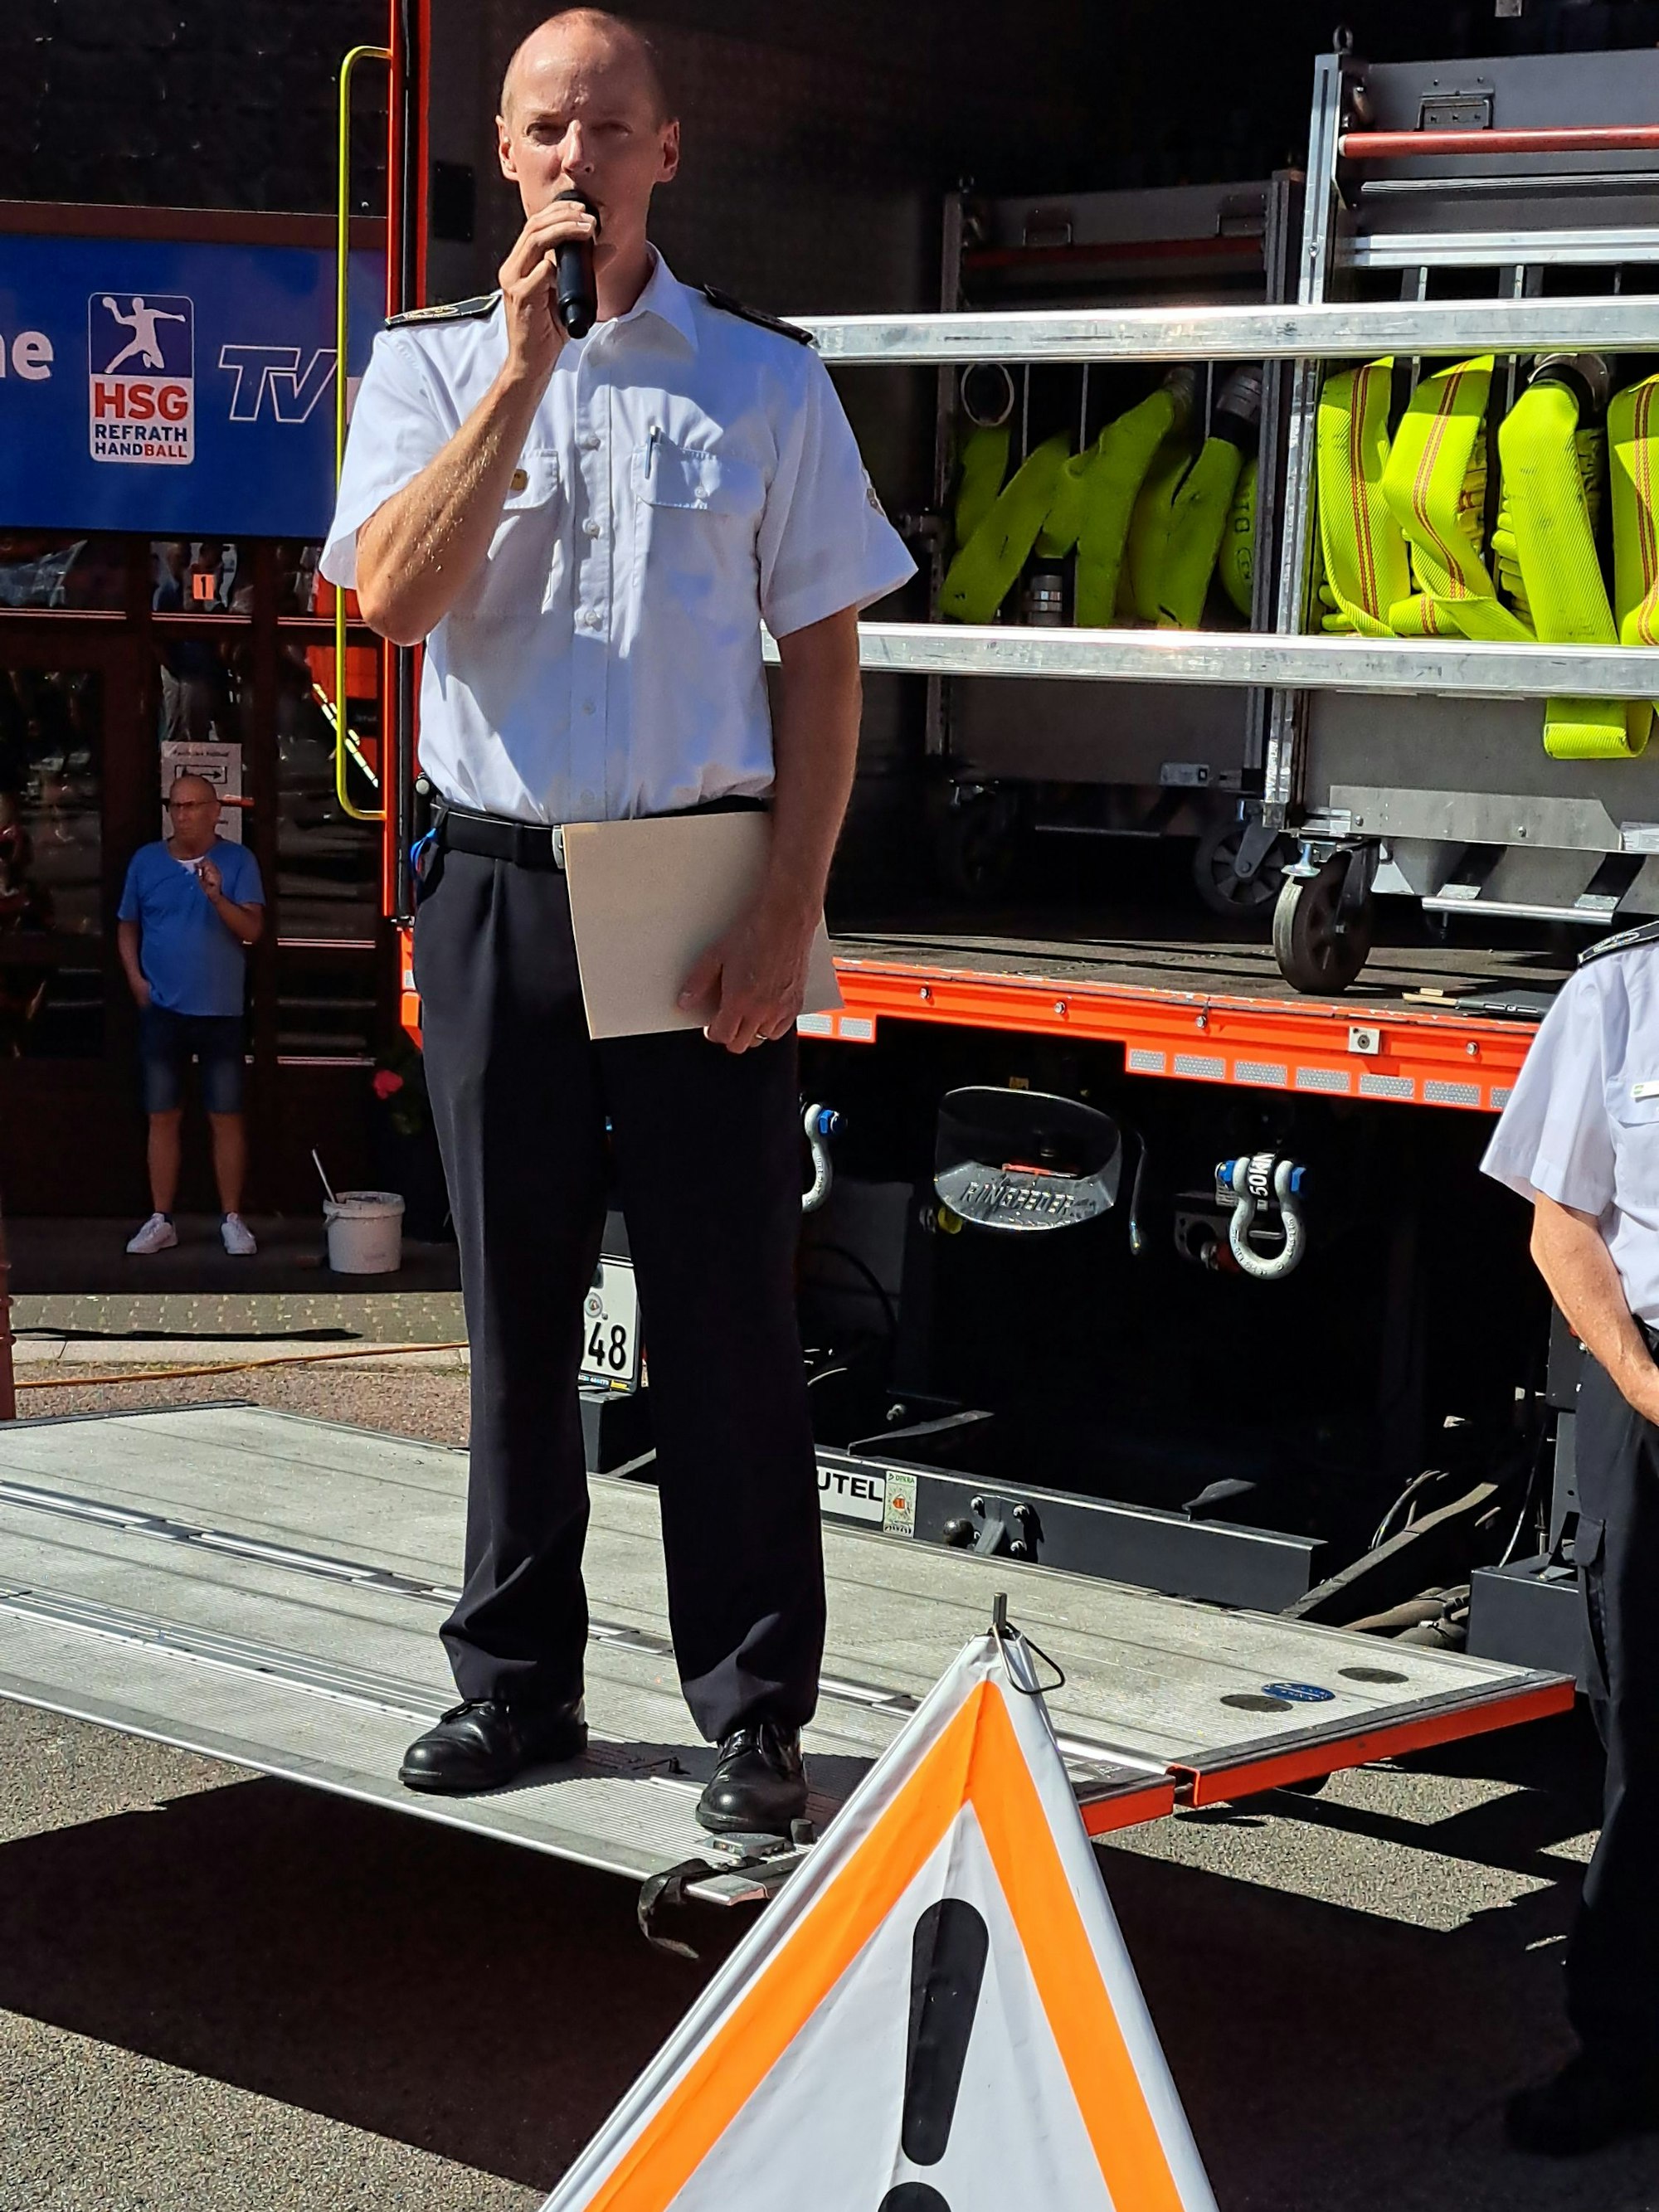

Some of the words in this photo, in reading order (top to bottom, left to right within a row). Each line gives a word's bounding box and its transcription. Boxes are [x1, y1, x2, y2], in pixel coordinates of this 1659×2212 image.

[0, 330, 54, 380] e
[95, 382, 188, 421] HSG
[219, 345, 338, 422] TV
[95, 424, 187, 442] REFRATH
[95, 442, 187, 458] HANDBALL
[588, 1322, 626, 1370] 48
[817, 1471, 883, 1502] UTEL
